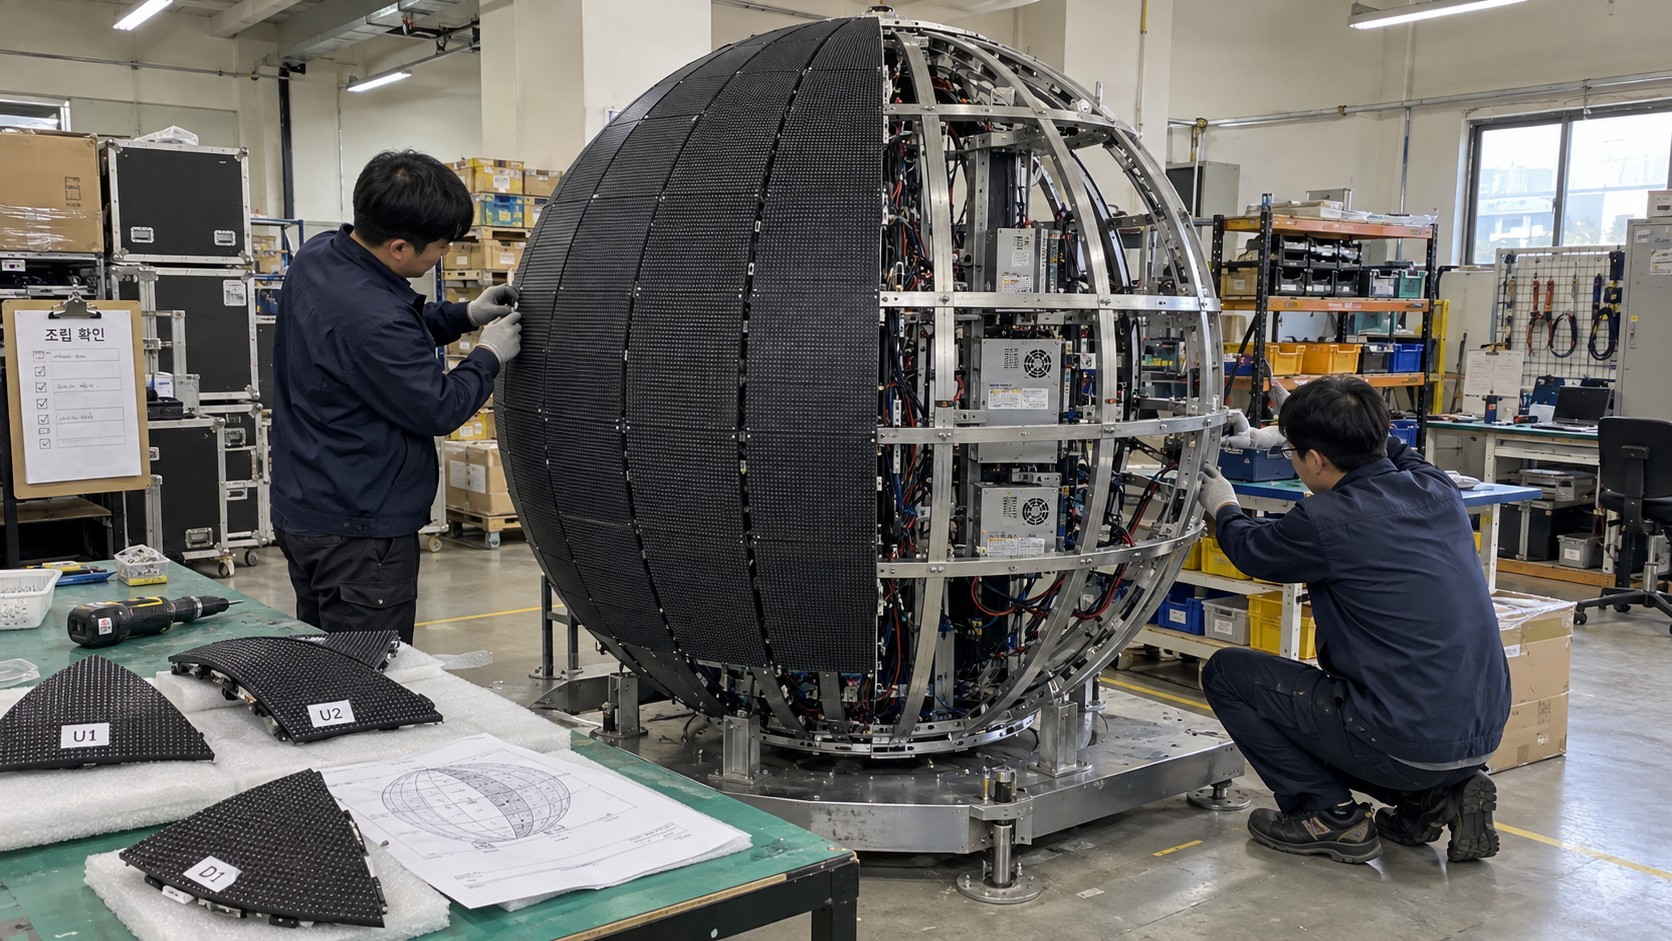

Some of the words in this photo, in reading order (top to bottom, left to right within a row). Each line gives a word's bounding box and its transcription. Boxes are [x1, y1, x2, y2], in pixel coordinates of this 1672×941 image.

[45, 328, 72, 342] 조립
[78, 327, 105, 342] 확인
[319, 707, 343, 721] U2
[73, 729, 97, 742] U1
[198, 865, 225, 882] D1
